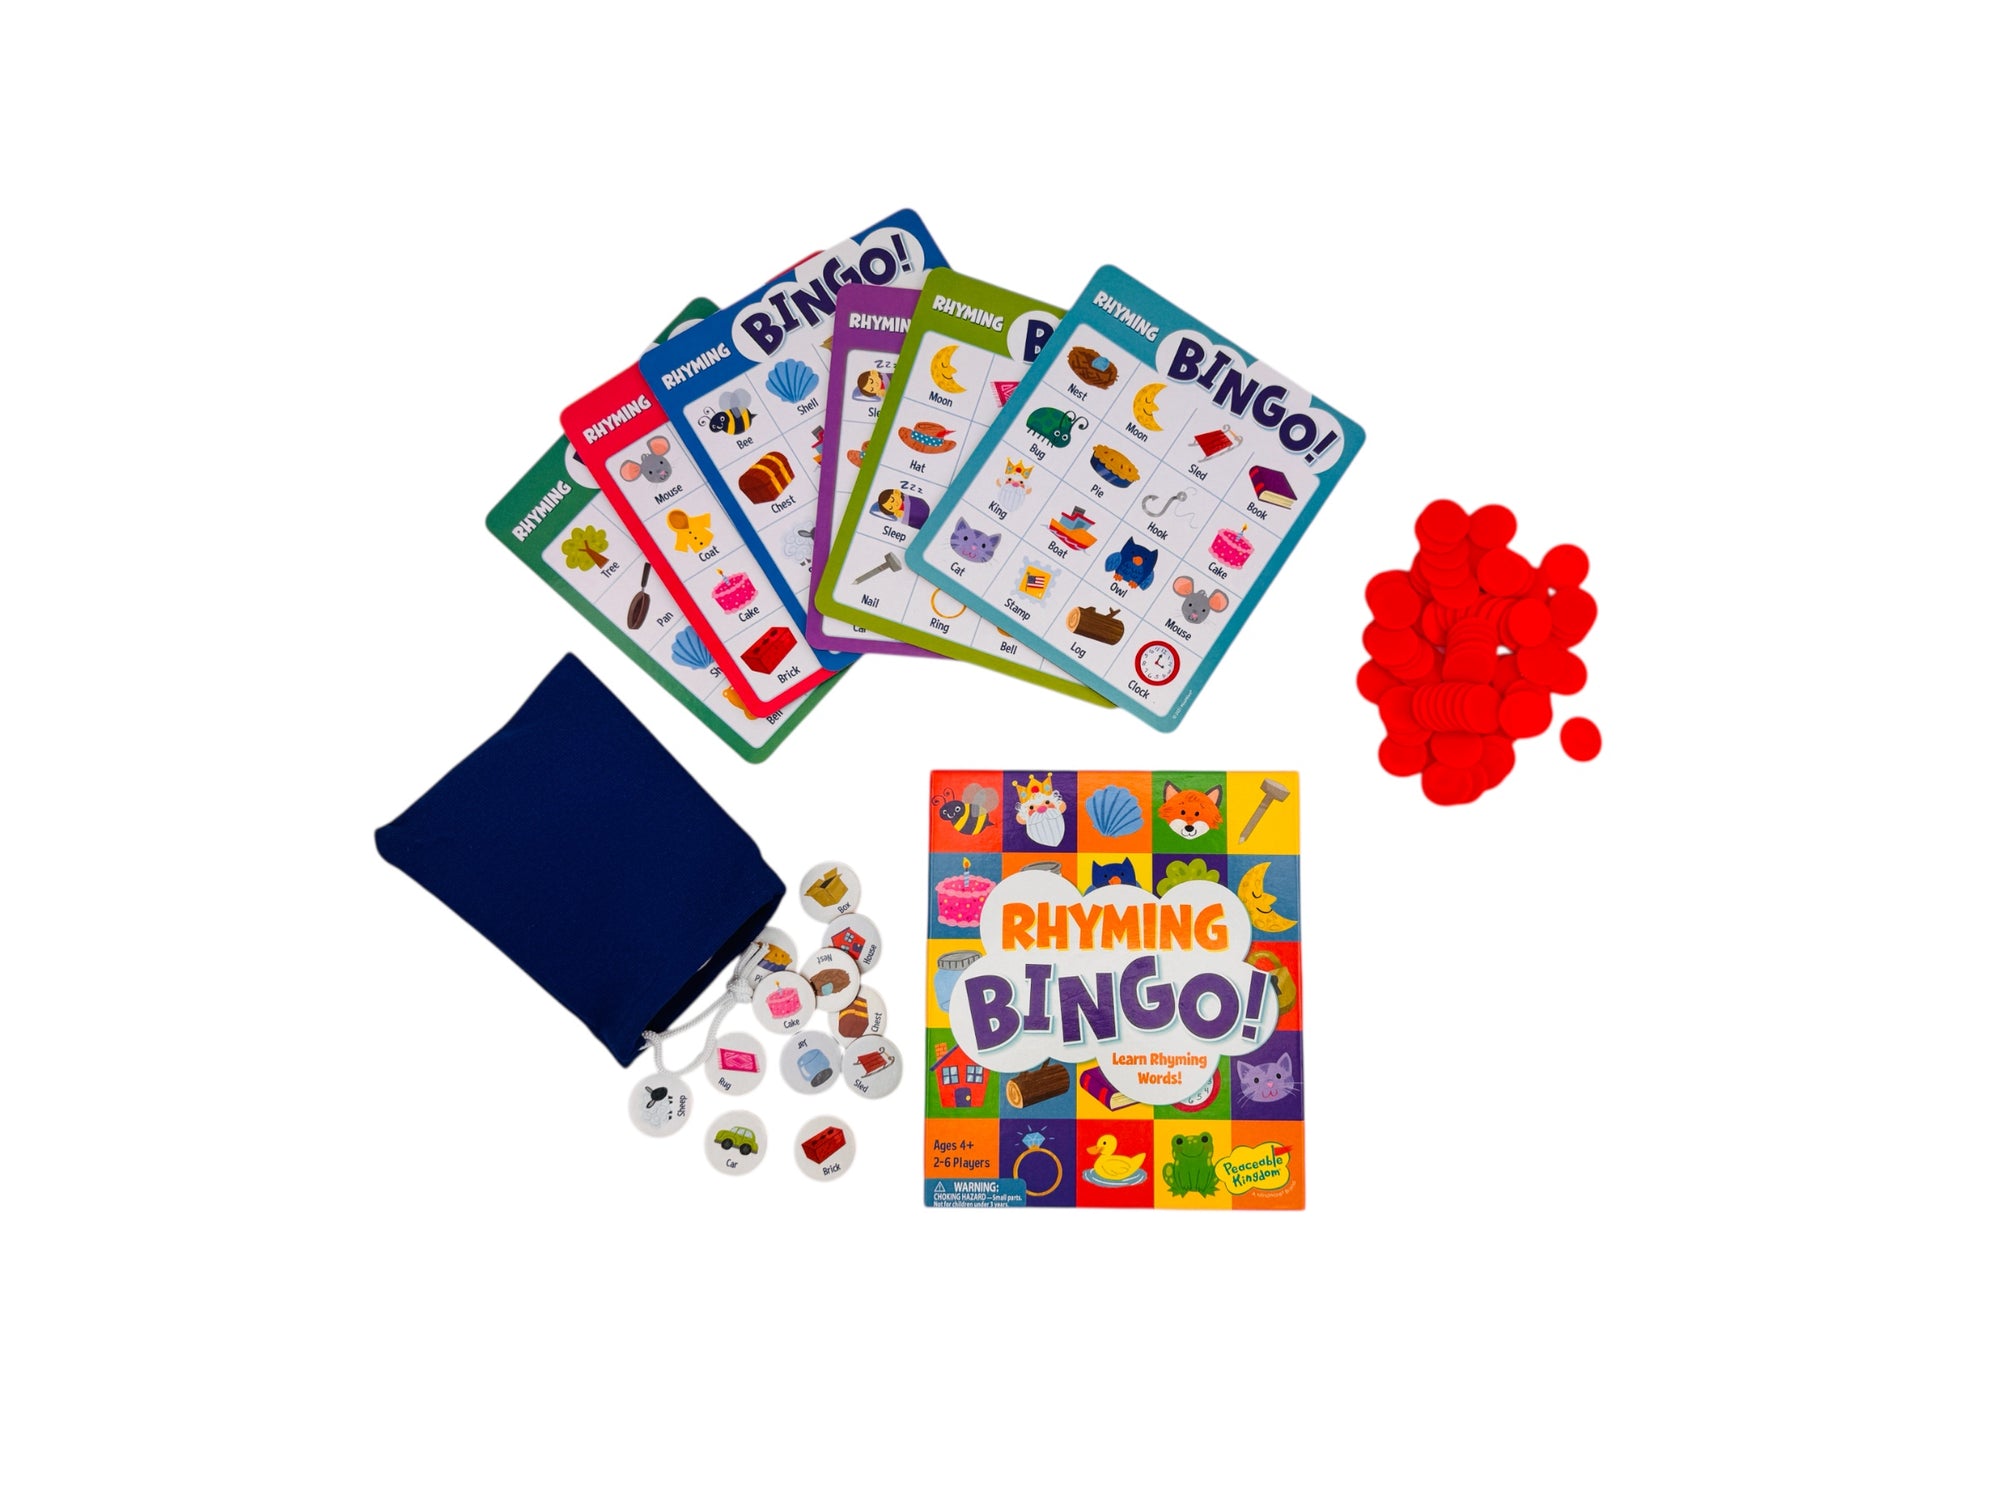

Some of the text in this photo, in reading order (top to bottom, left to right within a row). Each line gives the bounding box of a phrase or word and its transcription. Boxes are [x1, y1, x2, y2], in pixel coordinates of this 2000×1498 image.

[661, 233, 911, 390] RHYMING BINGO!
[932, 295, 1004, 332] RHYMING
[1092, 290, 1338, 464] RHYMING BINGO!
[928, 390, 954, 408] Moon
[1067, 382, 1088, 402] Nest
[797, 397, 819, 415] Shell
[582, 394, 652, 445] RHYMING
[1125, 421, 1148, 442] Moon
[736, 436, 754, 451] Bee
[1029, 443, 1046, 461] Bug
[910, 459, 927, 474] Hat
[1188, 463, 1208, 481] Sled
[654, 483, 684, 506] Mouse
[1090, 484, 1104, 499] Pie
[511, 480, 573, 542] RHYMING
[770, 494, 796, 514] Chest
[988, 500, 1008, 521] King
[1246, 501, 1268, 521] Book
[882, 525, 907, 542] Sleep
[1147, 521, 1169, 540] Hook
[697, 545, 720, 563] Coat
[1048, 540, 1068, 560] Boat
[600, 560, 620, 579] Tree
[950, 561, 966, 577] Cat
[1208, 561, 1228, 580] Cake
[1109, 582, 1128, 599] Owl
[860, 593, 880, 609] Nail
[1004, 597, 1031, 621] Stamp
[656, 610, 674, 627] Pan
[738, 605, 760, 623] Cake
[929, 616, 950, 634] Ring
[1165, 618, 1192, 642] Mouse
[999, 641, 1017, 656] Bell
[1070, 641, 1087, 659] Log
[776, 665, 801, 685] Brick
[1127, 679, 1150, 700] Clock
[837, 901, 852, 914] Box
[1001, 902, 1230, 952] RHYMING
[816, 953, 833, 965] Nest
[862, 943, 878, 966] House
[964, 955, 1270, 1052] BINGO!
[783, 1018, 800, 1029] Cake
[871, 1012, 882, 1033] Chest
[797, 1038, 808, 1050] Jar
[1112, 1051, 1208, 1069] Learn Rhyming
[718, 1076, 732, 1091] Rug
[853, 1078, 869, 1094] Sled
[1137, 1071, 1183, 1085] Words!
[677, 1094, 688, 1117] Sheep
[933, 1139, 975, 1153] Ages 4+
[725, 1158, 738, 1169] Car
[822, 1162, 841, 1177] Brick
[933, 1156, 990, 1171] 2-6 Players
[1223, 1151, 1283, 1175] Peaceable
[954, 1181, 999, 1193] WARNING:
[1232, 1169, 1281, 1187] Kingdom
[933, 1193, 961, 1201] CHOKING
